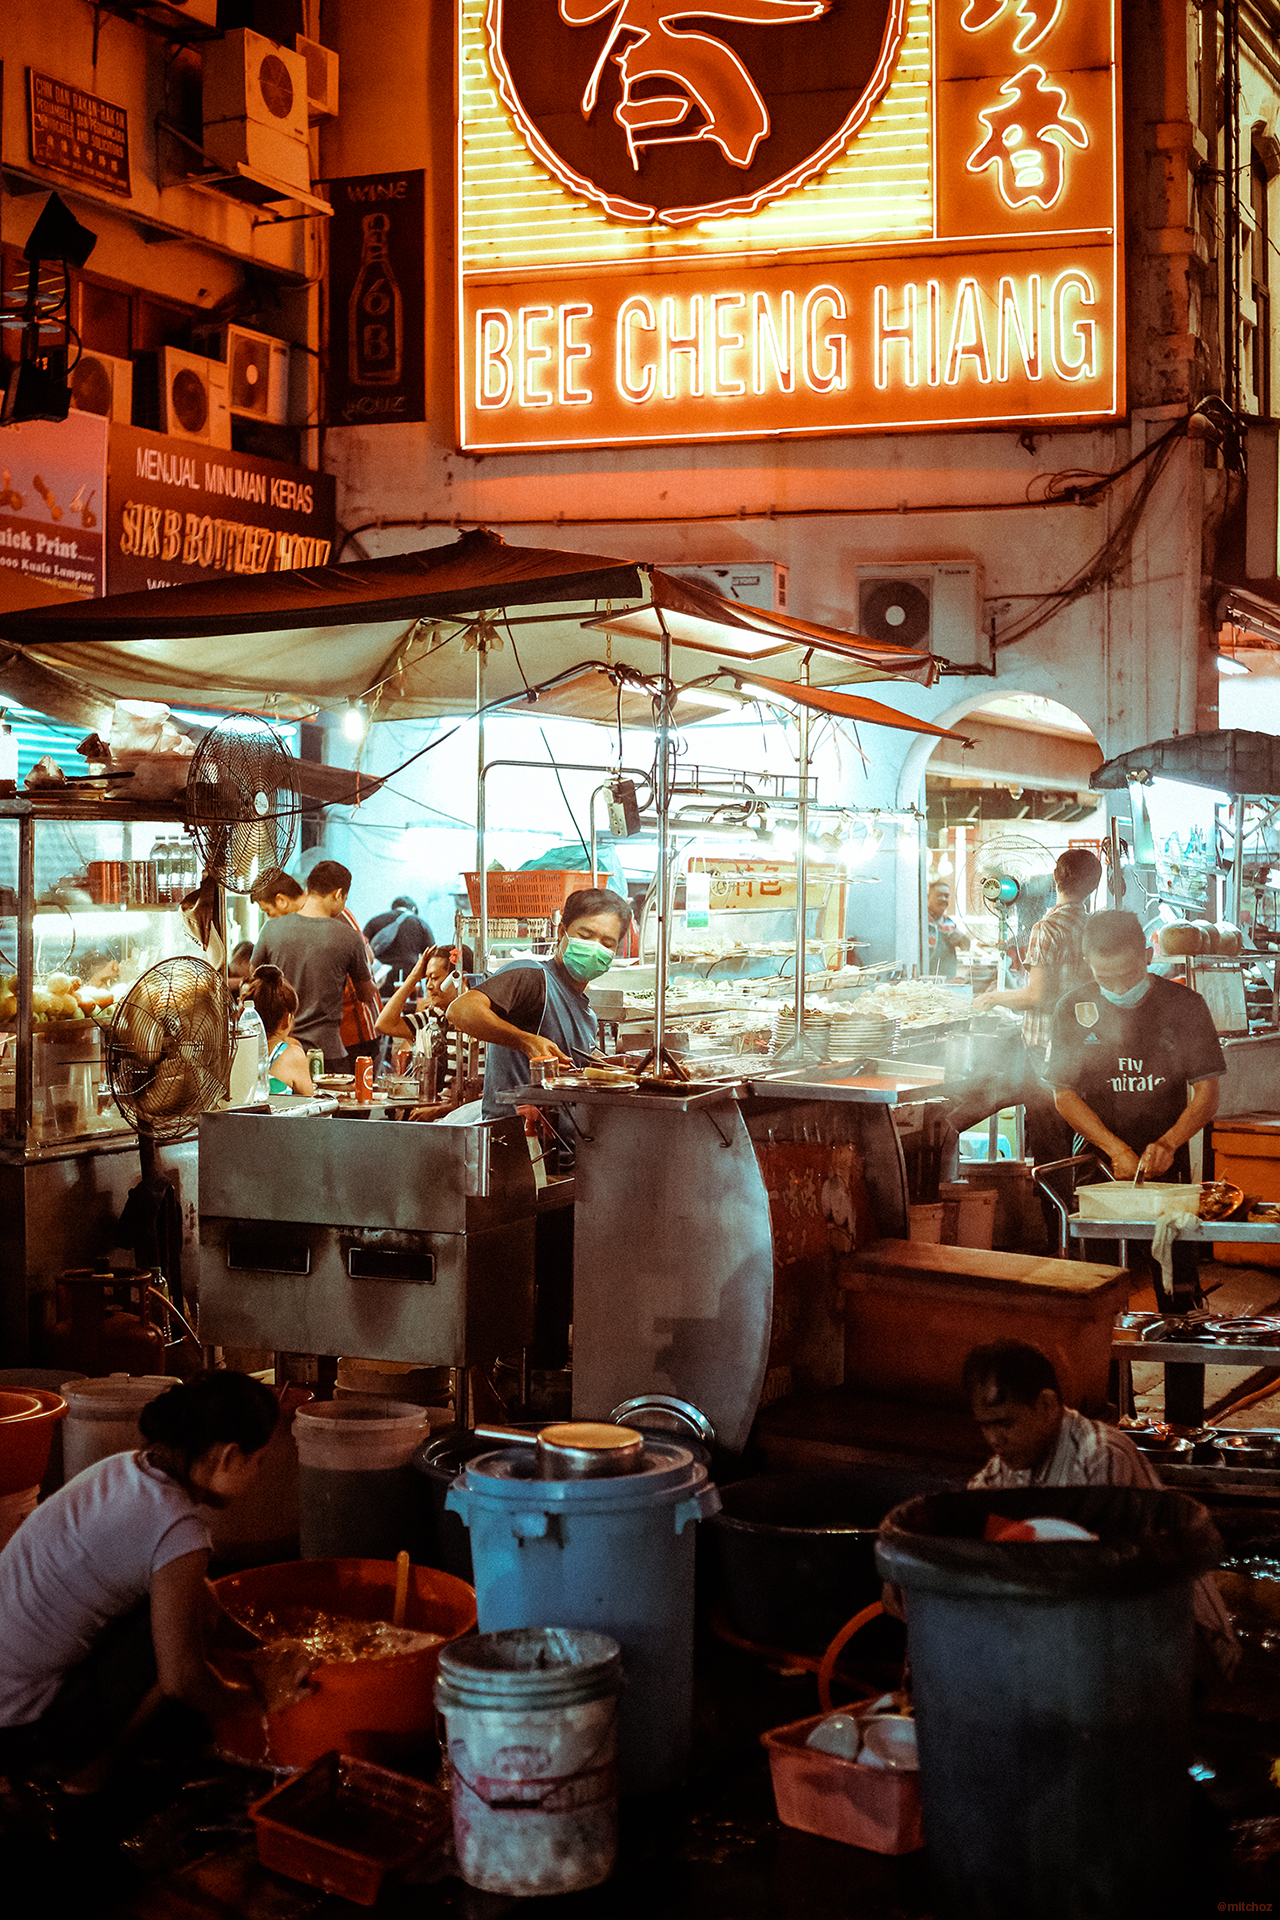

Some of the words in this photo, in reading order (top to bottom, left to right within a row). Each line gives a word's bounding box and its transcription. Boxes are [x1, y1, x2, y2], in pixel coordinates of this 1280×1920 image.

[348, 181, 408, 202] WINE
[475, 303, 593, 410] BEE
[615, 284, 848, 405] CHENG
[873, 269, 1096, 390] HIANG
[136, 447, 200, 489] MENJUAL
[205, 462, 267, 504] MINUMAN
[270, 477, 314, 514] KERAS
[36, 533, 79, 559] Print
[21, 558, 52, 574] Kuala
[1118, 1058, 1143, 1073] Fly
